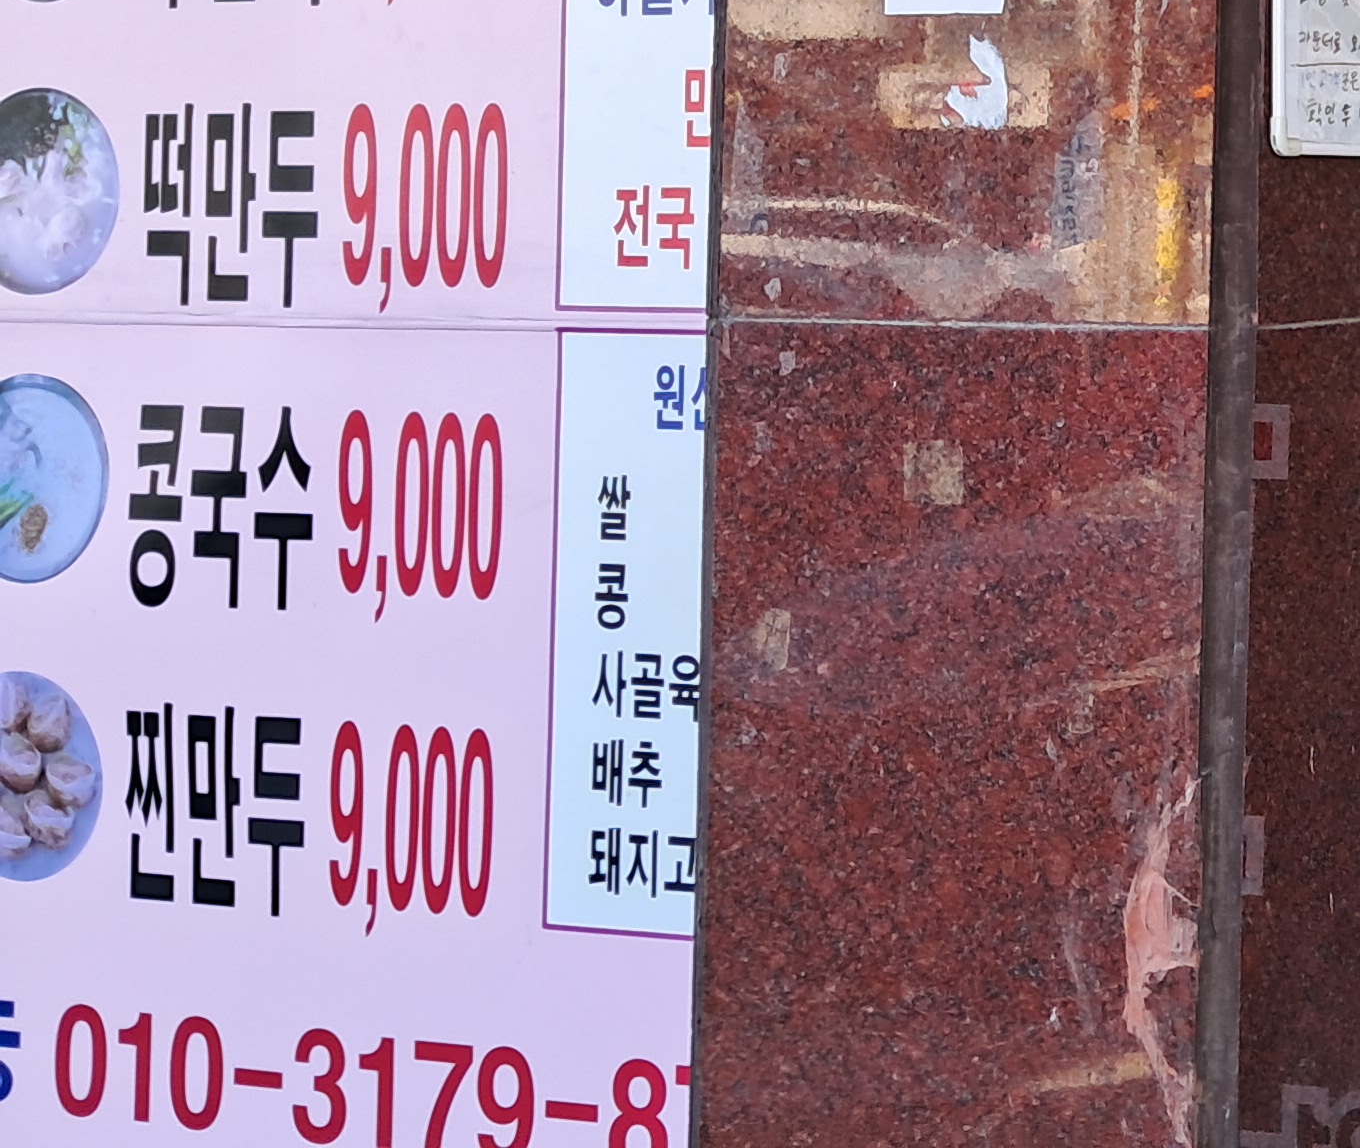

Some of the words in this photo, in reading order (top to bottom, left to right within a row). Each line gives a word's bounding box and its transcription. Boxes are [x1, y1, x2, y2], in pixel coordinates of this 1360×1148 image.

[1298, 30, 1342, 55] 카운터로
[143, 103, 318, 308] 떡만두
[343, 103, 508, 313] 9,000
[613, 185, 695, 270] 전국
[128, 405, 314, 610] 콩국수
[338, 409, 502, 623] 9,000
[598, 474, 631, 541] 쌀
[594, 563, 628, 629] 콩
[125, 702, 305, 917] 찐만두
[329, 720, 493, 936] 9,000
[592, 739, 662, 809] 배추
[588, 827, 697, 899] 돼지고
